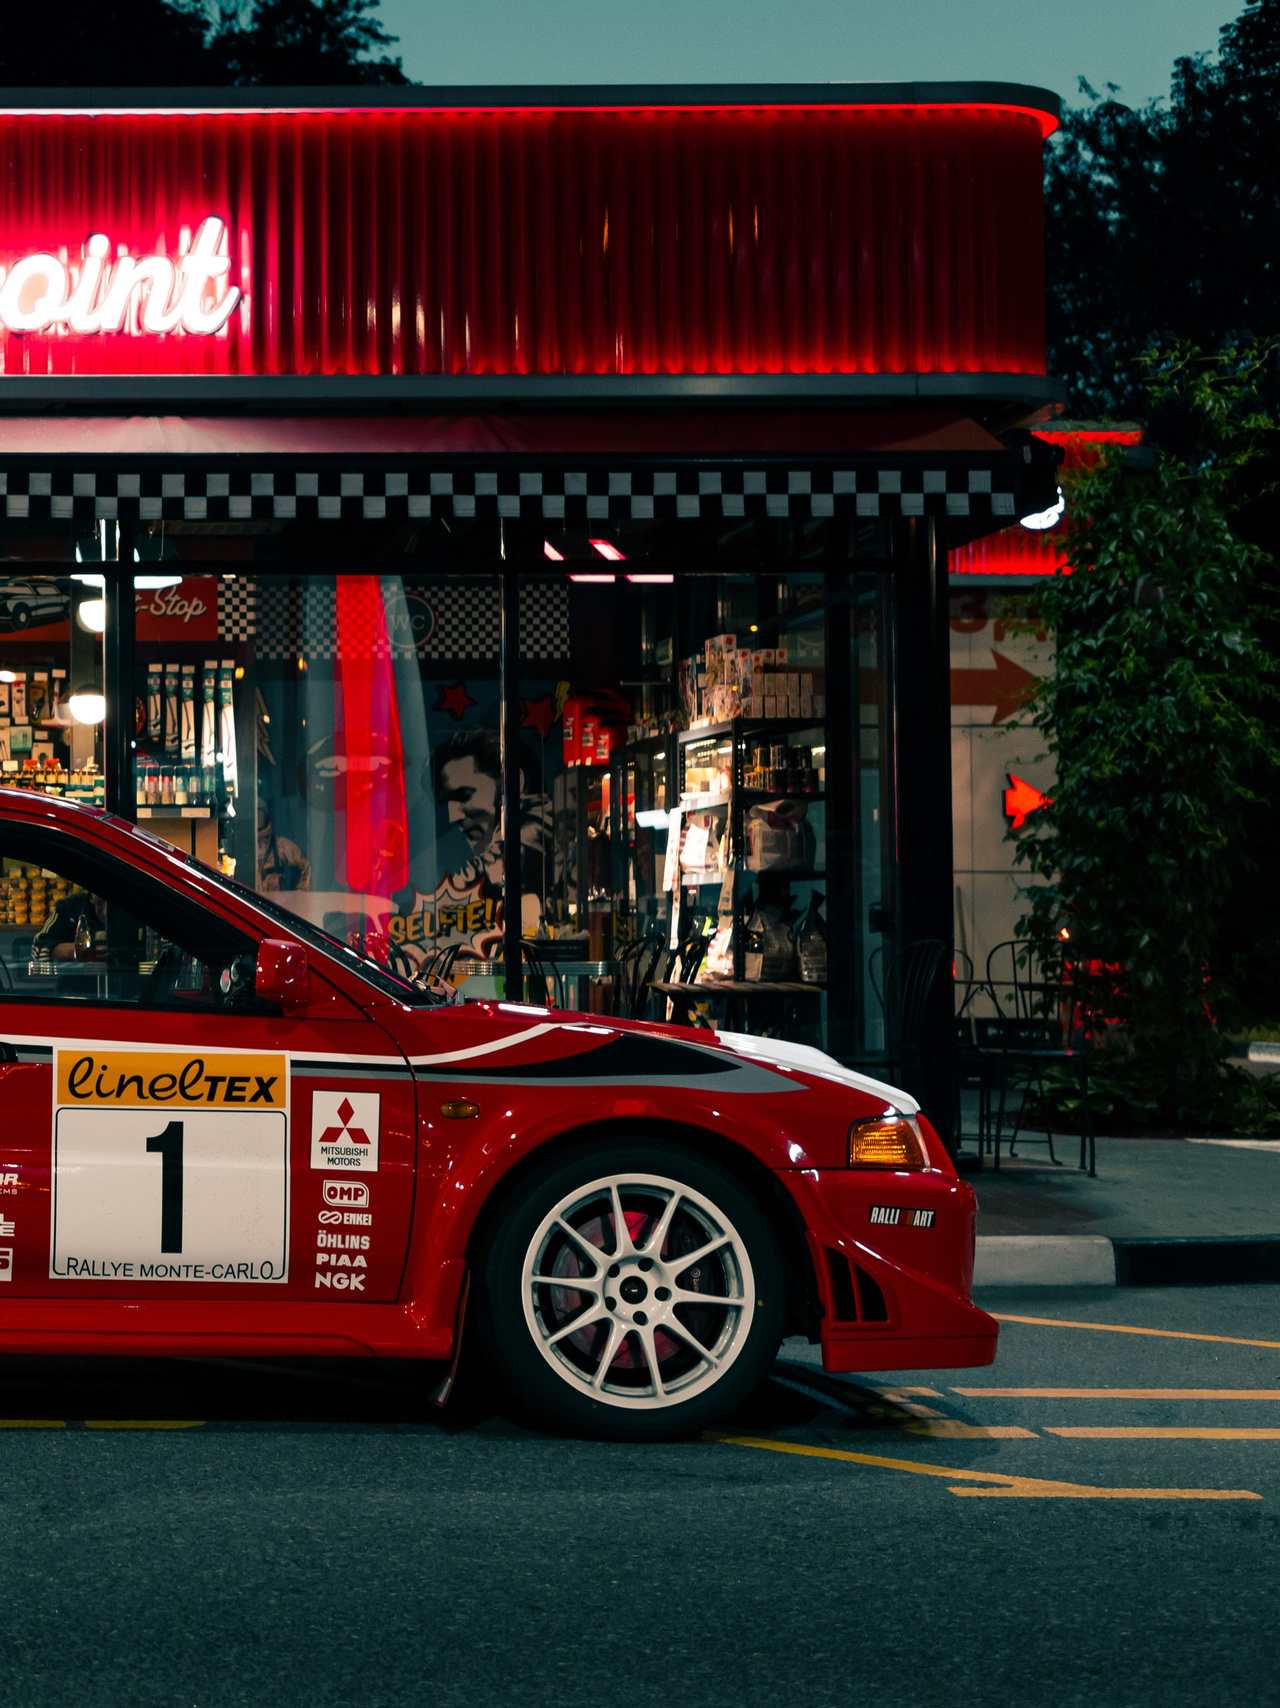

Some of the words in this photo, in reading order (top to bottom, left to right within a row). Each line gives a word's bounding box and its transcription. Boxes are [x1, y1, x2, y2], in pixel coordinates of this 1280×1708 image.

[390, 615, 425, 631] WC
[321, 1146, 368, 1156] MITSUBISHI
[327, 1157, 361, 1166] MOTORS
[146, 1121, 184, 1254] 1
[326, 1186, 365, 1201] OMP
[343, 1212, 372, 1226] ENKEI
[317, 1230, 370, 1250] ÖHLINS
[316, 1252, 367, 1267] PIAA
[66, 1257, 134, 1277] RALLYE
[140, 1261, 274, 1280] MONTE-CARLO
[314, 1271, 366, 1291] NGK
